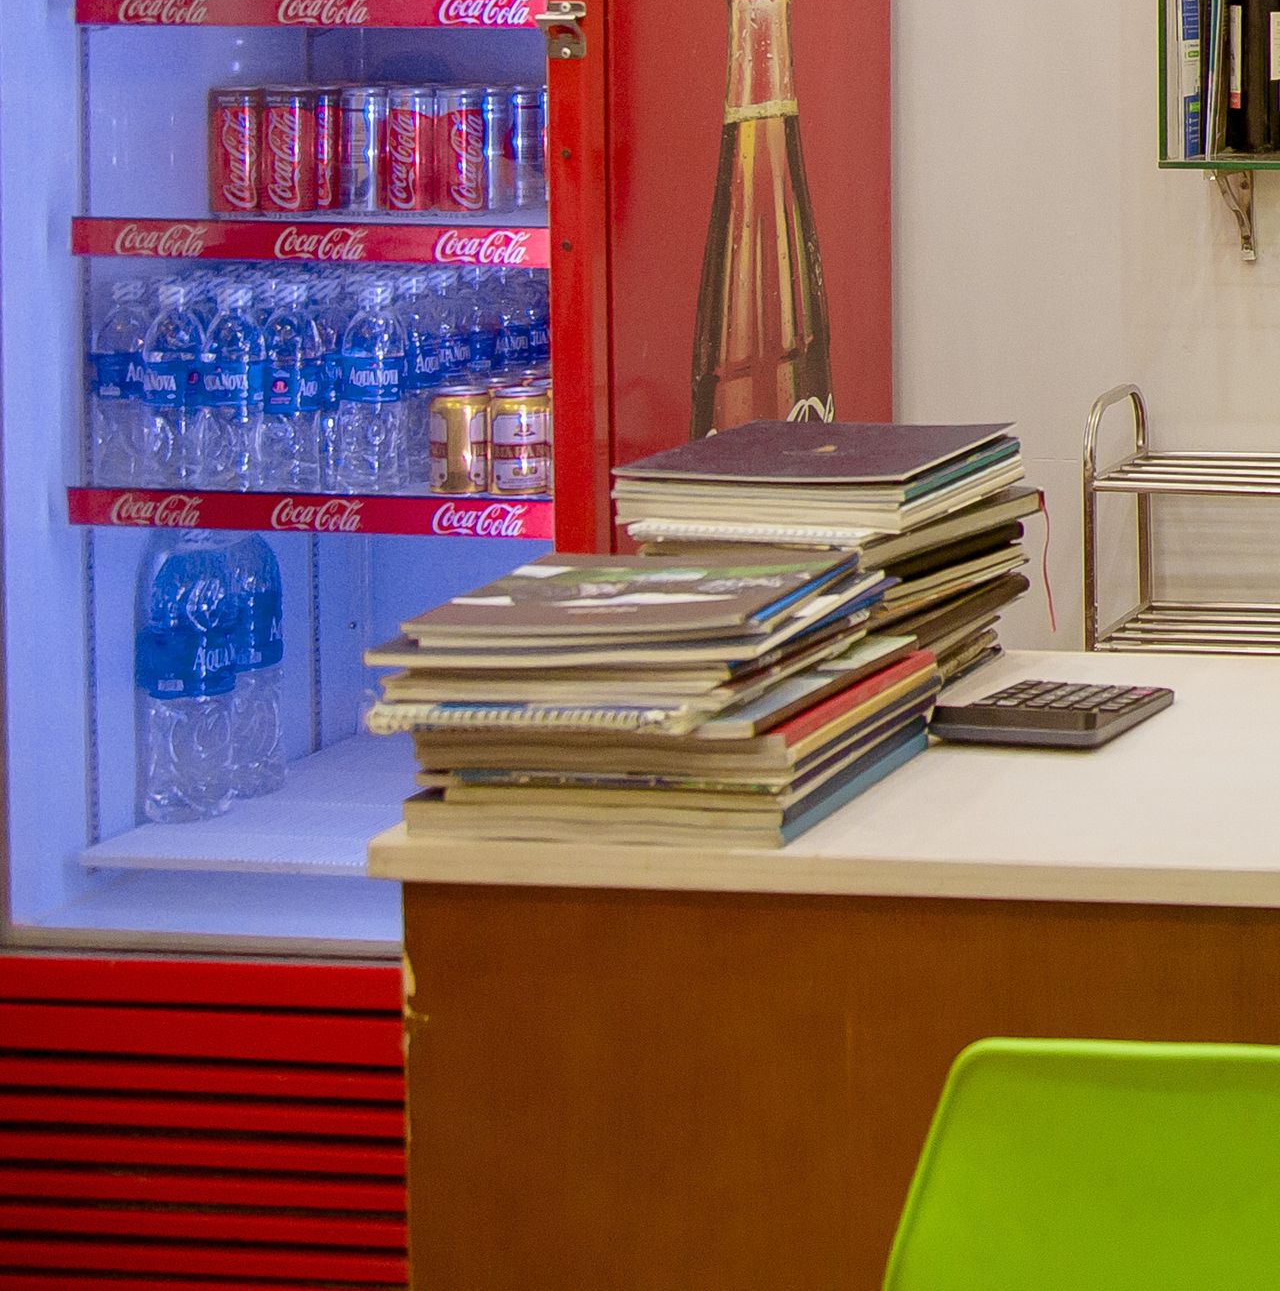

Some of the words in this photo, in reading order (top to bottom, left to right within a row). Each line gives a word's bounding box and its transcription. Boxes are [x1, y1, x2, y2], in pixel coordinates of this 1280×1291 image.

[115, 224, 206, 257] Coca-Cola
[274, 226, 366, 261] Coca-Cola
[435, 229, 529, 264] Coca-Cola
[111, 493, 204, 527] Coca-Cola
[271, 497, 363, 533] Coca-Cola
[432, 501, 526, 537] Coca-Cola
